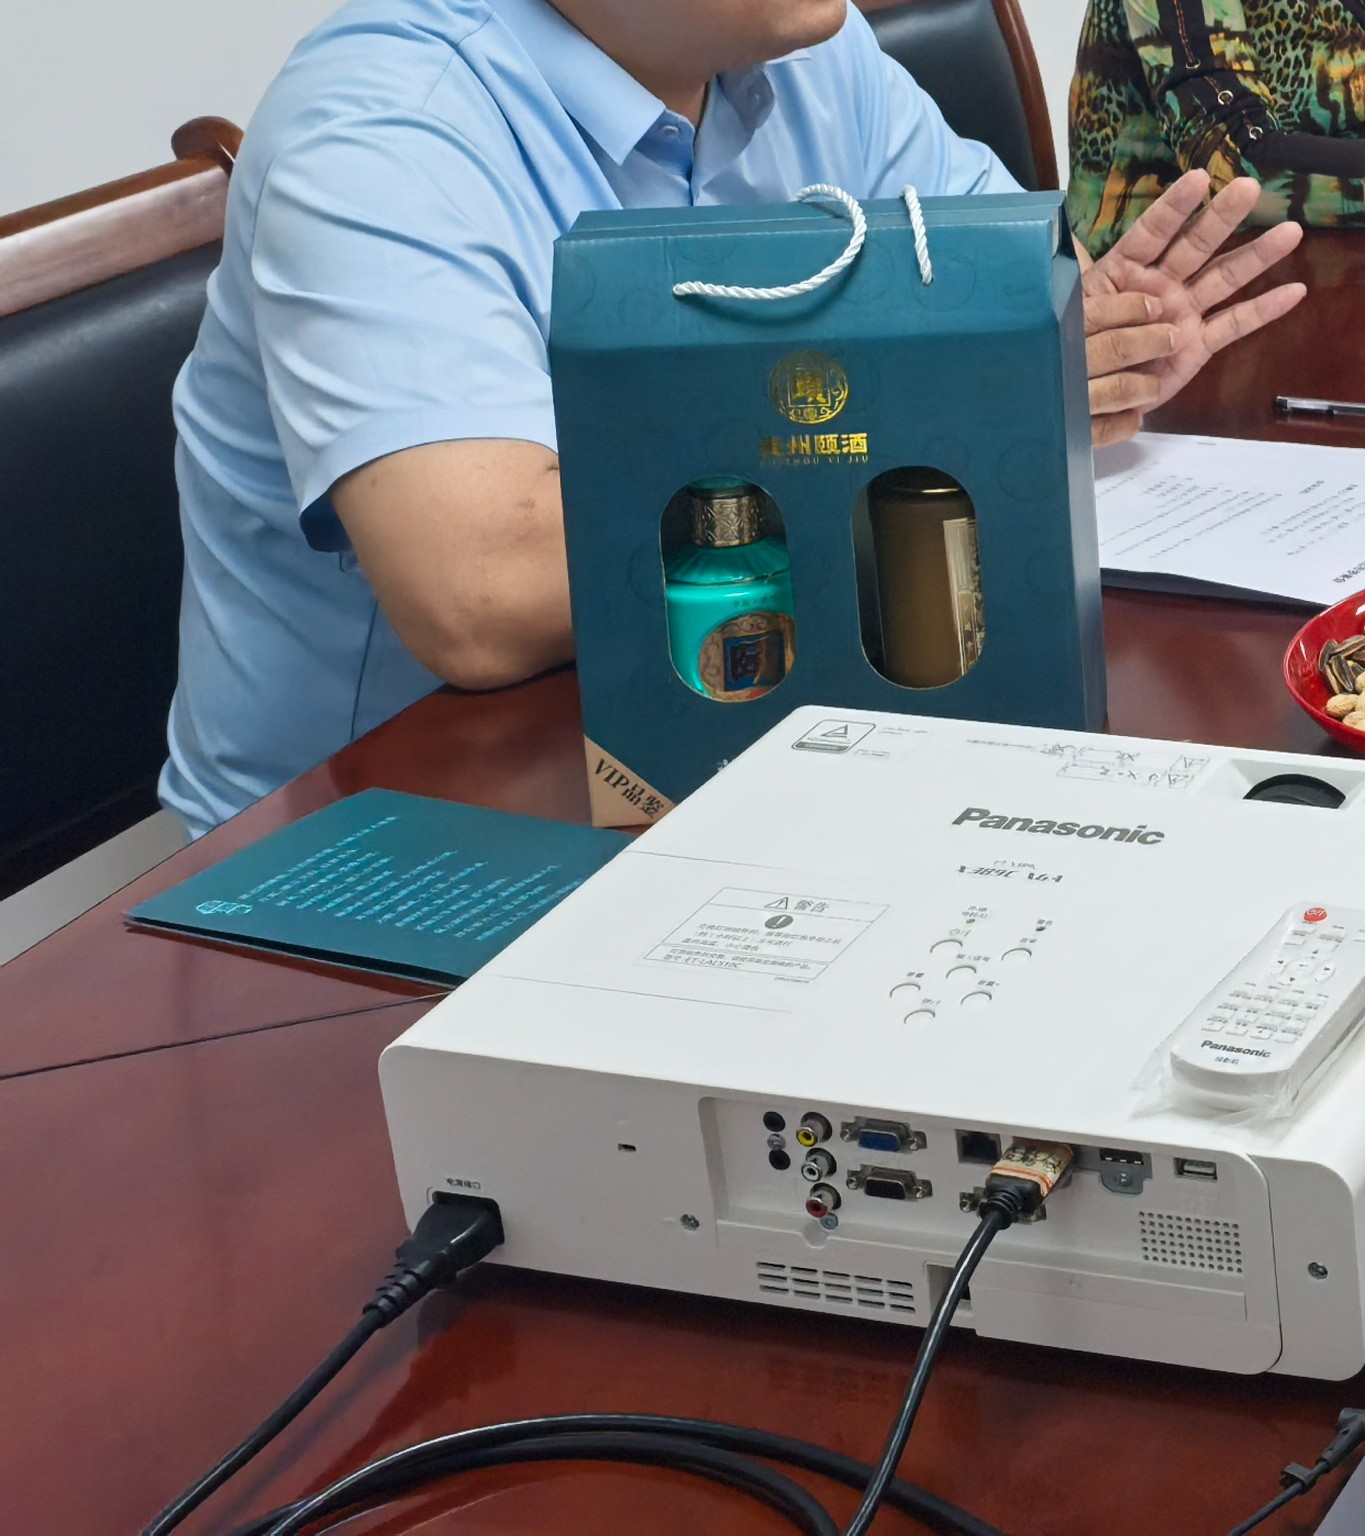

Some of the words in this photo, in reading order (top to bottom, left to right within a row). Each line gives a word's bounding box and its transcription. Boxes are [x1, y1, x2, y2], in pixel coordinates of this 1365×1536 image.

[593, 758, 665, 819] VIP品鉴
[952, 807, 1165, 846] Panasonic
[1201, 1040, 1271, 1058] Panasonic
